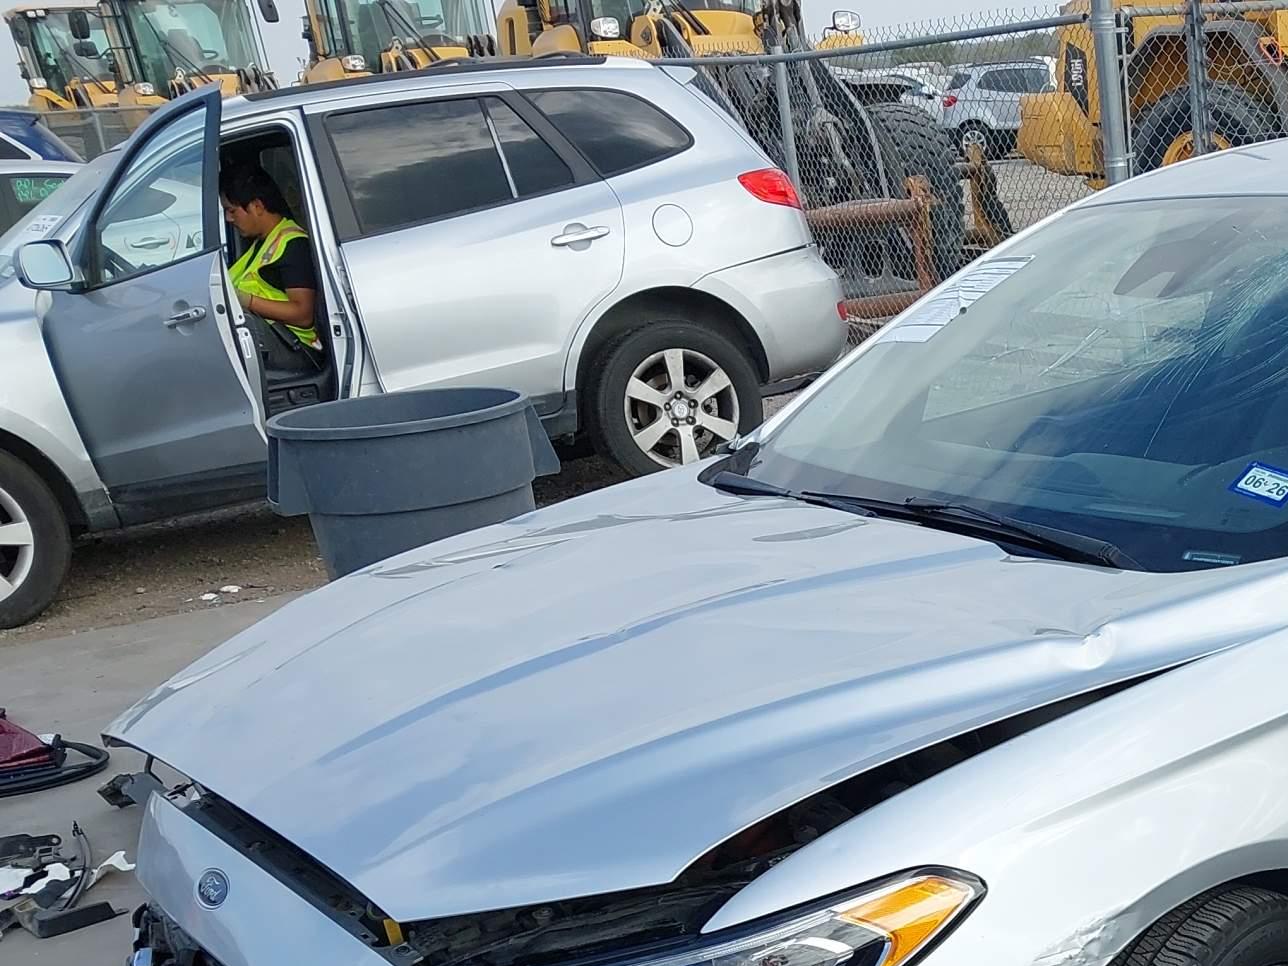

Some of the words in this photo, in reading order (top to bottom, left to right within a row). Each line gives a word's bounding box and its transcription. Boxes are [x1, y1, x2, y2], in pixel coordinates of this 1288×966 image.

[1244, 475, 1265, 489] 06
[1266, 482, 1288, 496] 26
[200, 875, 223, 902] Ford
